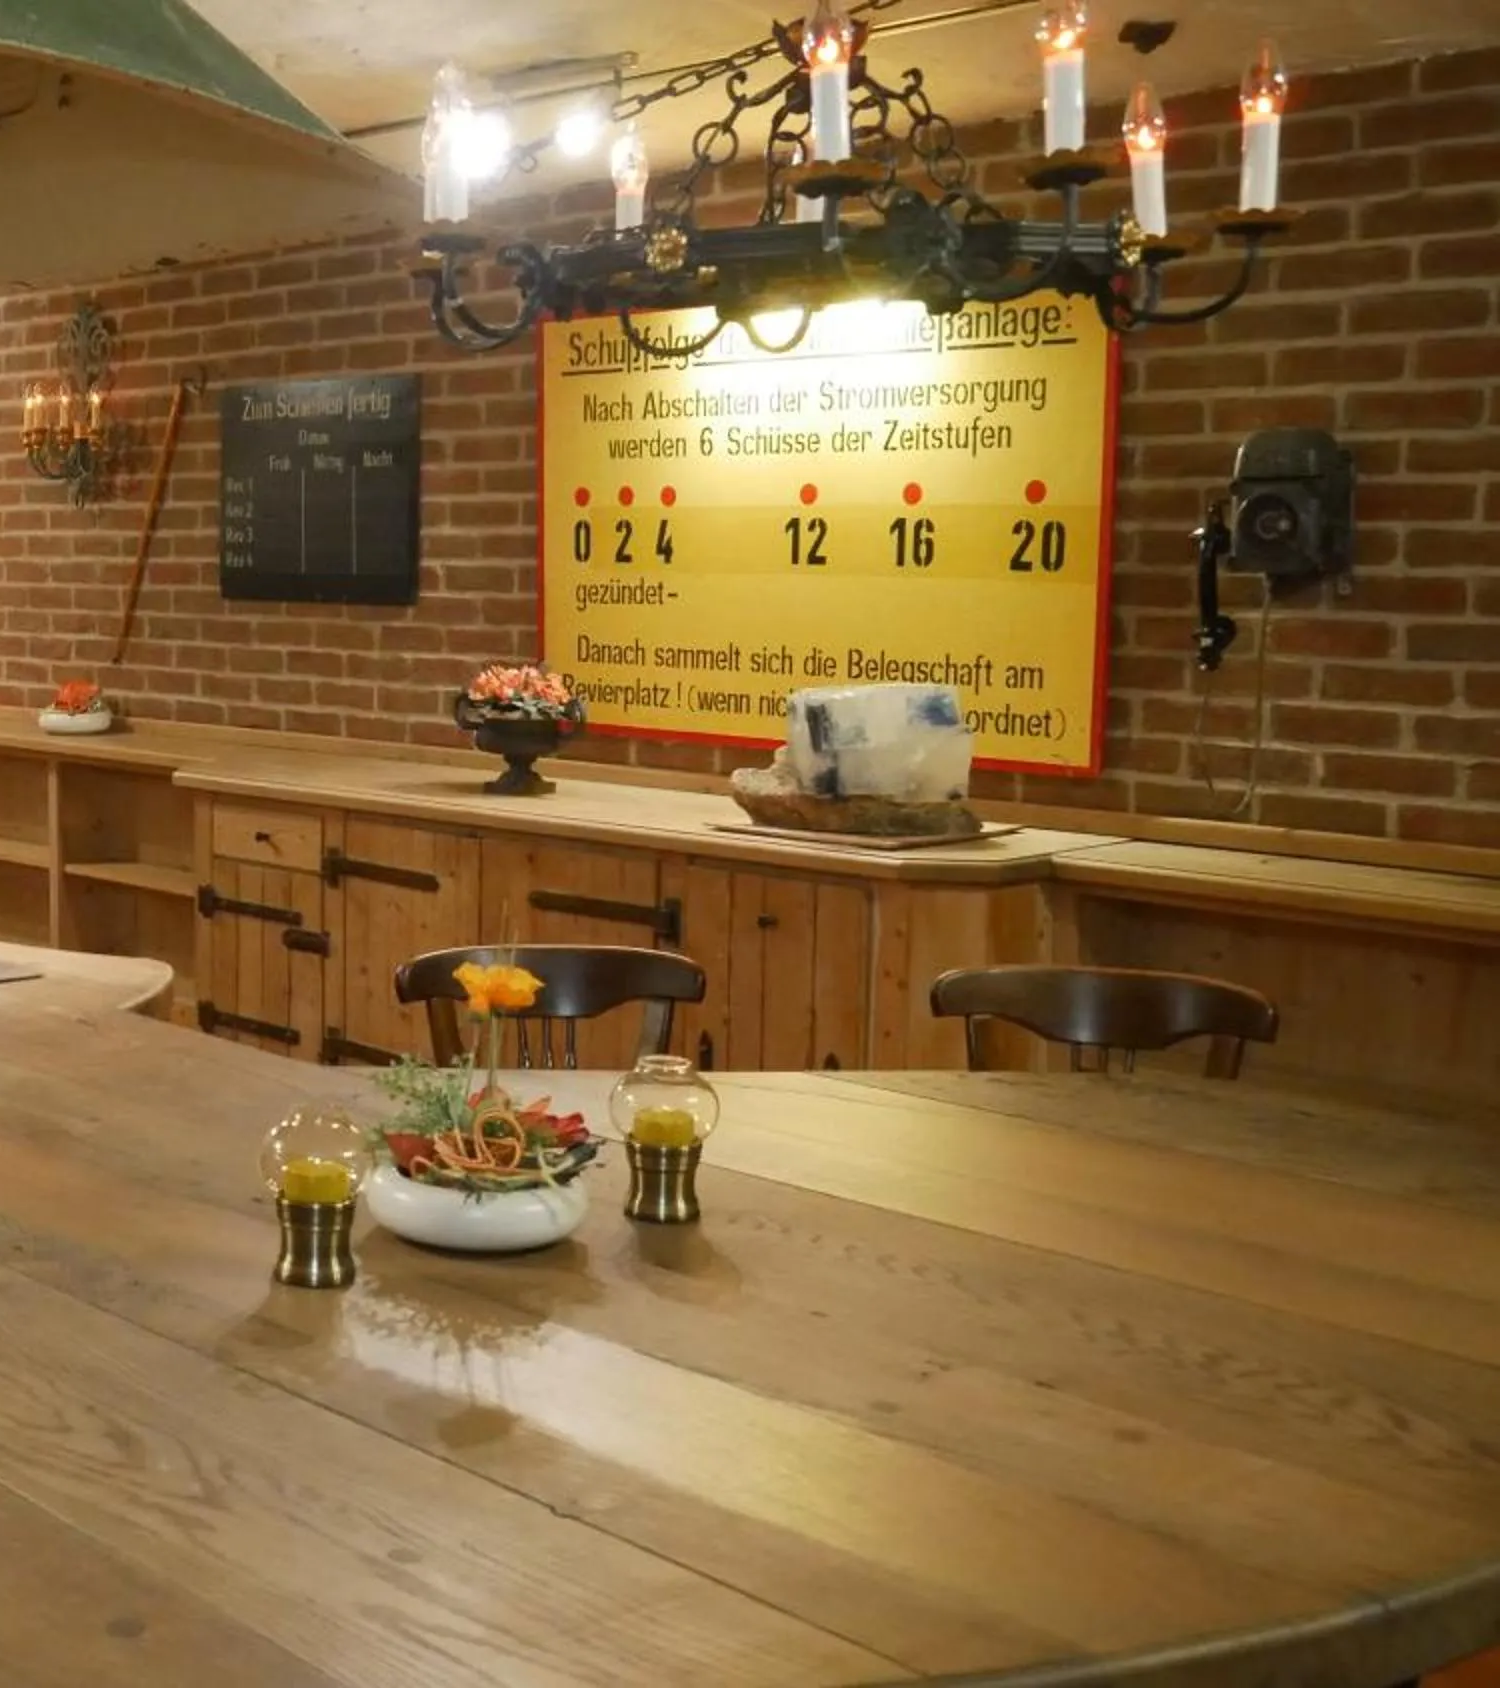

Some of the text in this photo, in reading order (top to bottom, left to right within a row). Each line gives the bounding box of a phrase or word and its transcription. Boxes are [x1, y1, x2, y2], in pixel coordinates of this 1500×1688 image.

[241, 396, 274, 421] Zum
[582, 376, 1048, 422] Nach Abschalten der Stromversorgung
[608, 415, 1013, 459] werden 6 Schüsse der Zeitstufen
[246, 526, 254, 544] 3
[574, 517, 1067, 572] 0 2 4 12 16 20
[576, 634, 1045, 696] Danach sammelt sich die Belegschaft am
[686, 685, 751, 716] (wenn
[758, 686, 792, 718] nic
[964, 703, 1067, 741] ordnet)
